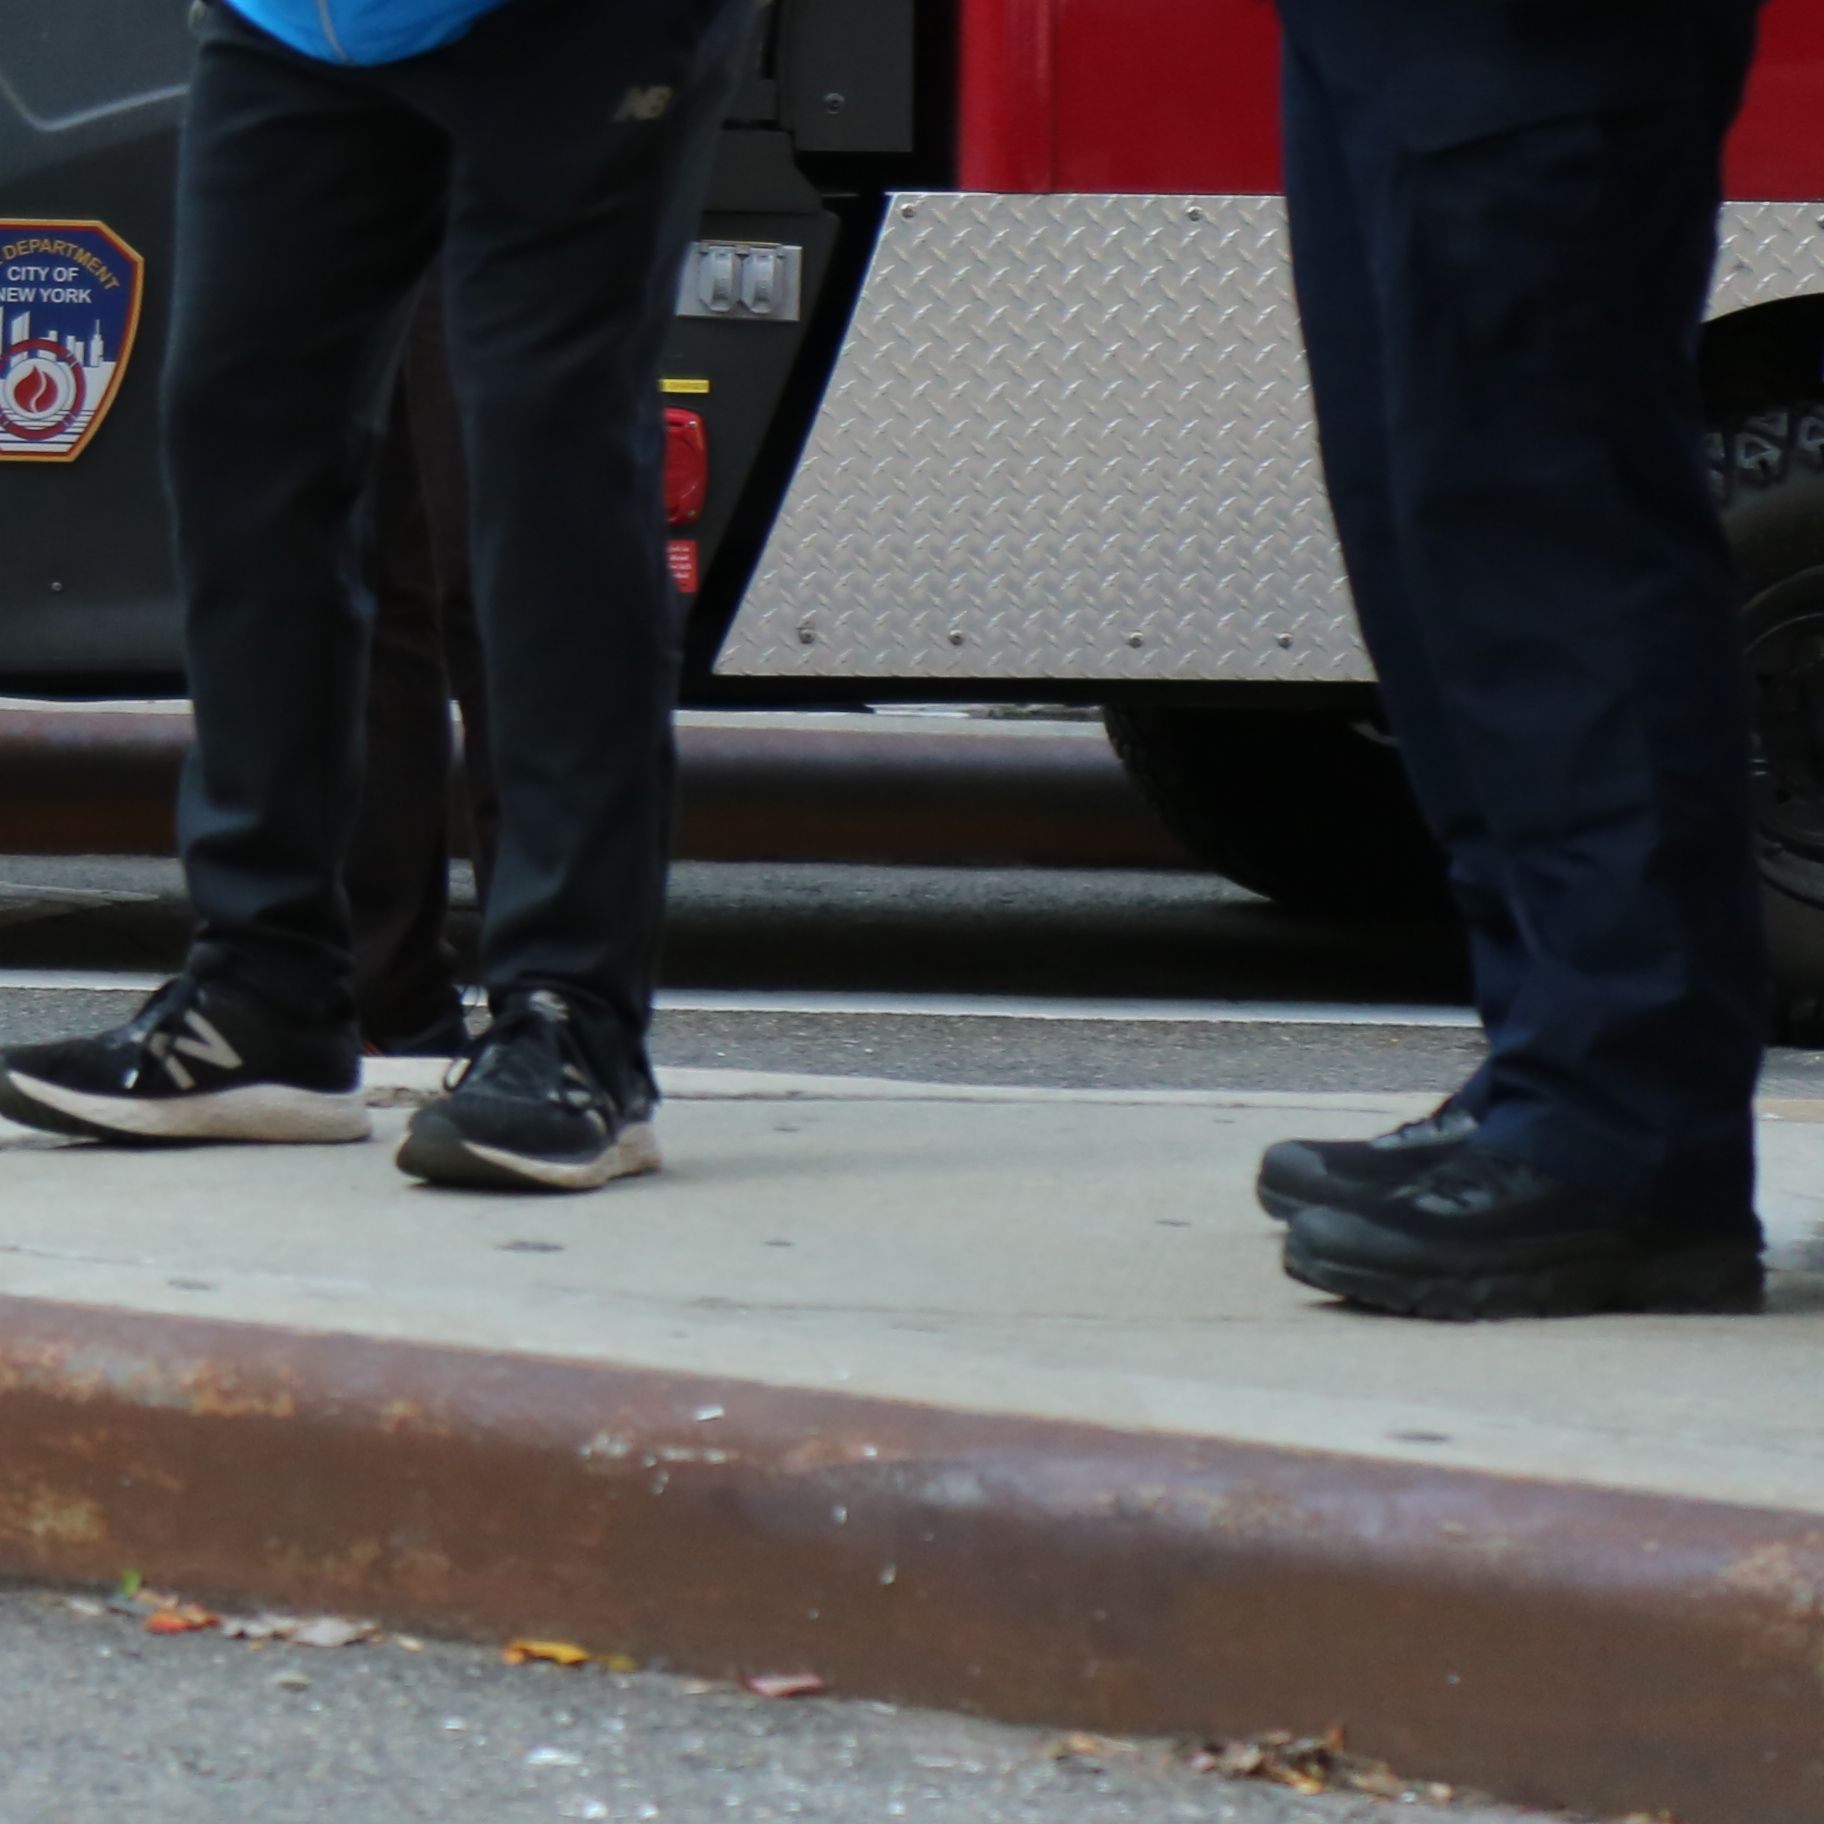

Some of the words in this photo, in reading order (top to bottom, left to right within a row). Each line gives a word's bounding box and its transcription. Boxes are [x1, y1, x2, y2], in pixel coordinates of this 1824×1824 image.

[3, 238, 121, 291] DEPARTMENT
[7, 266, 50, 282] CITY
[52, 266, 80, 283] OF
[40, 287, 93, 304] YORK
